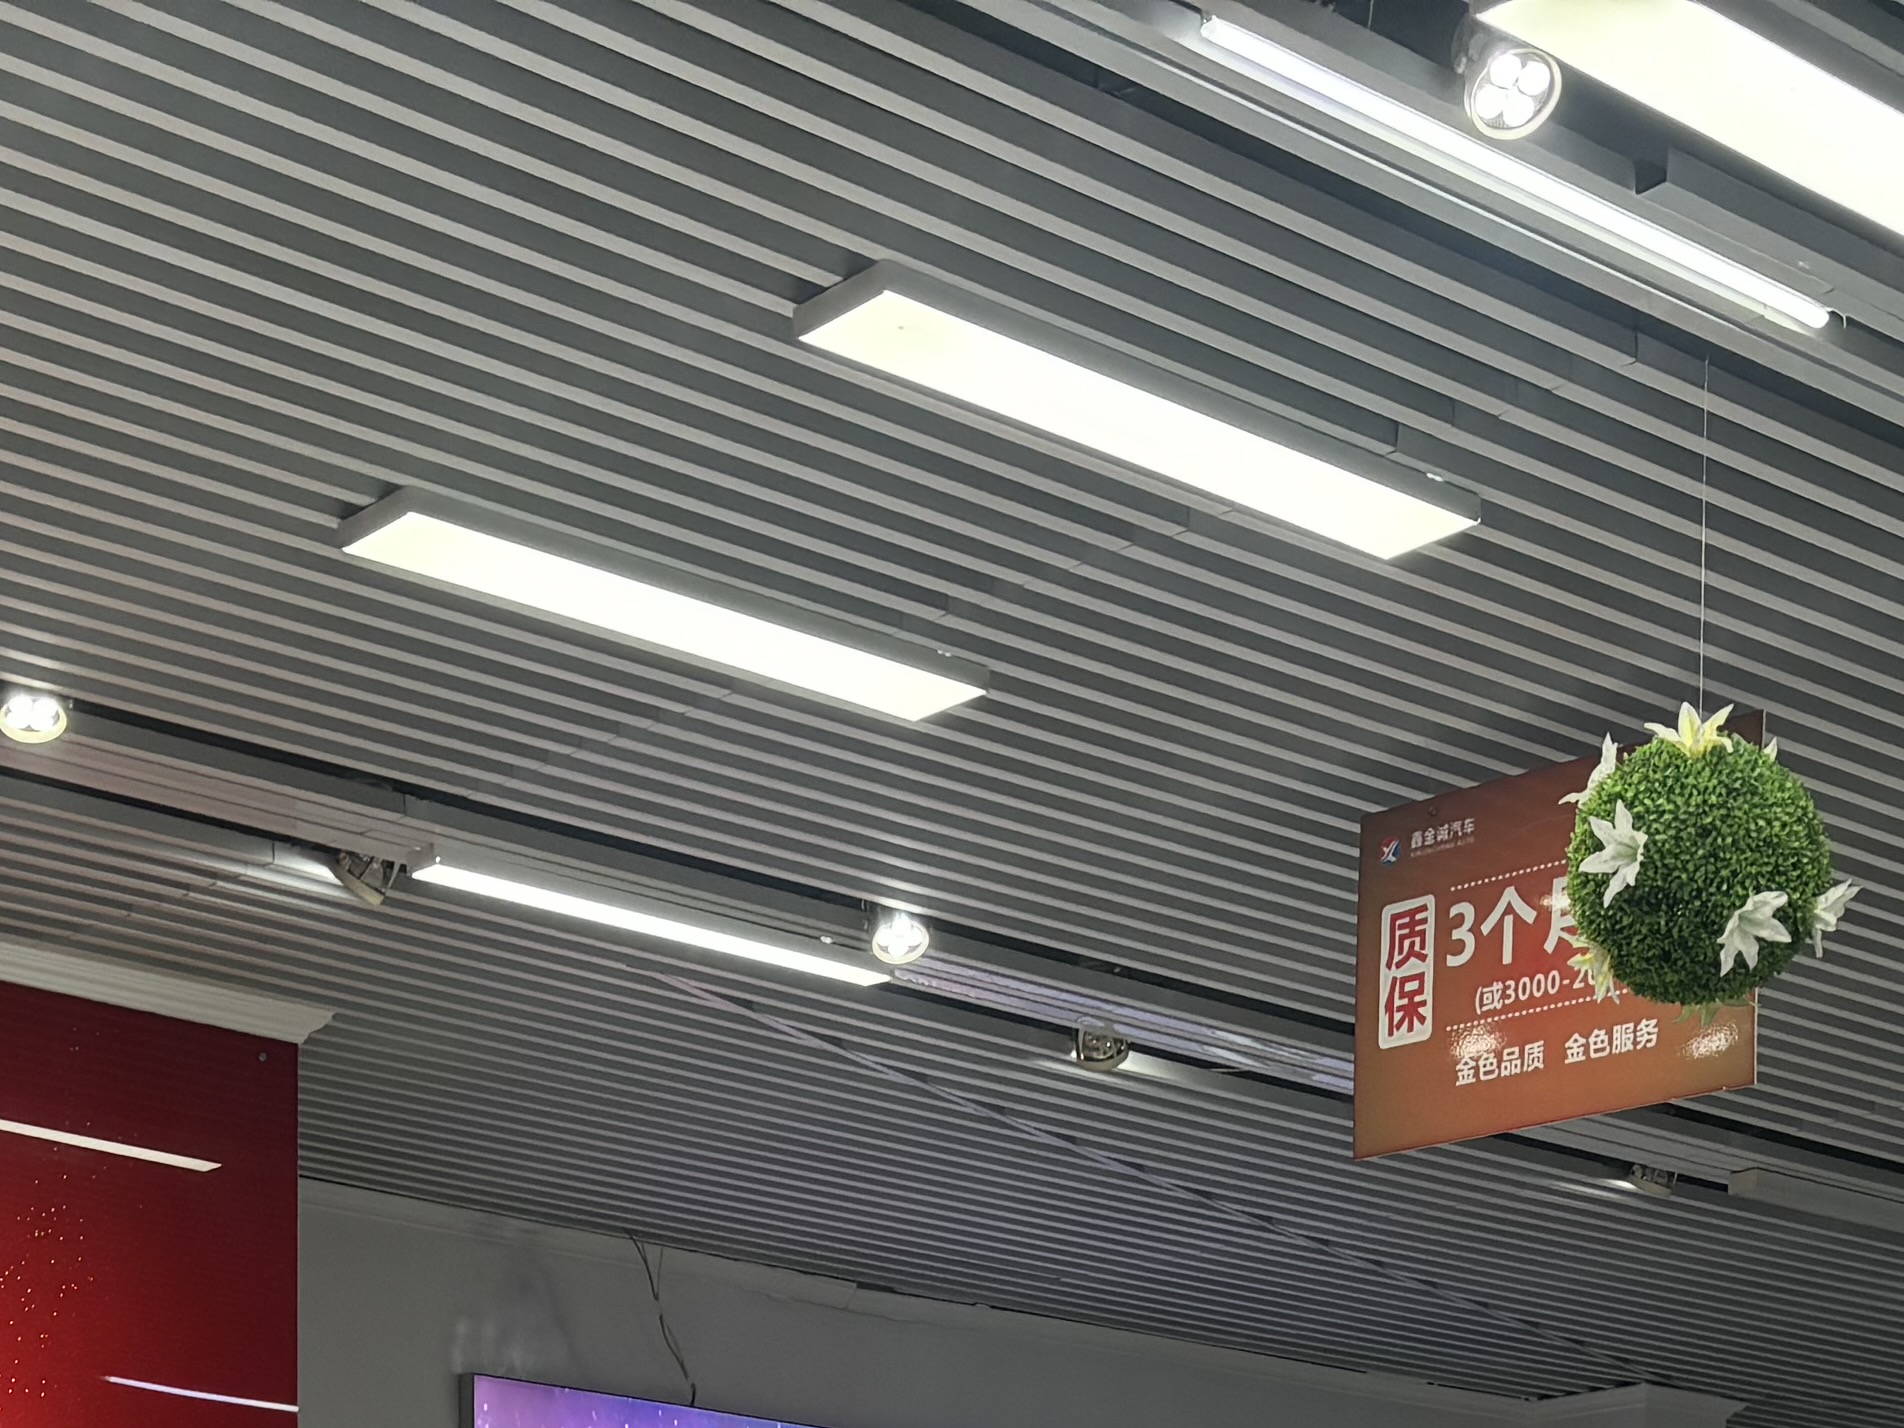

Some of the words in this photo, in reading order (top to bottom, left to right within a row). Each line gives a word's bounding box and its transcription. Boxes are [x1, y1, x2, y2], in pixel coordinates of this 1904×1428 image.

[1384, 904, 1429, 1037] 质保
[1455, 1040, 1545, 1087] 金色品质
[1564, 1019, 1659, 1065] 金色服务
